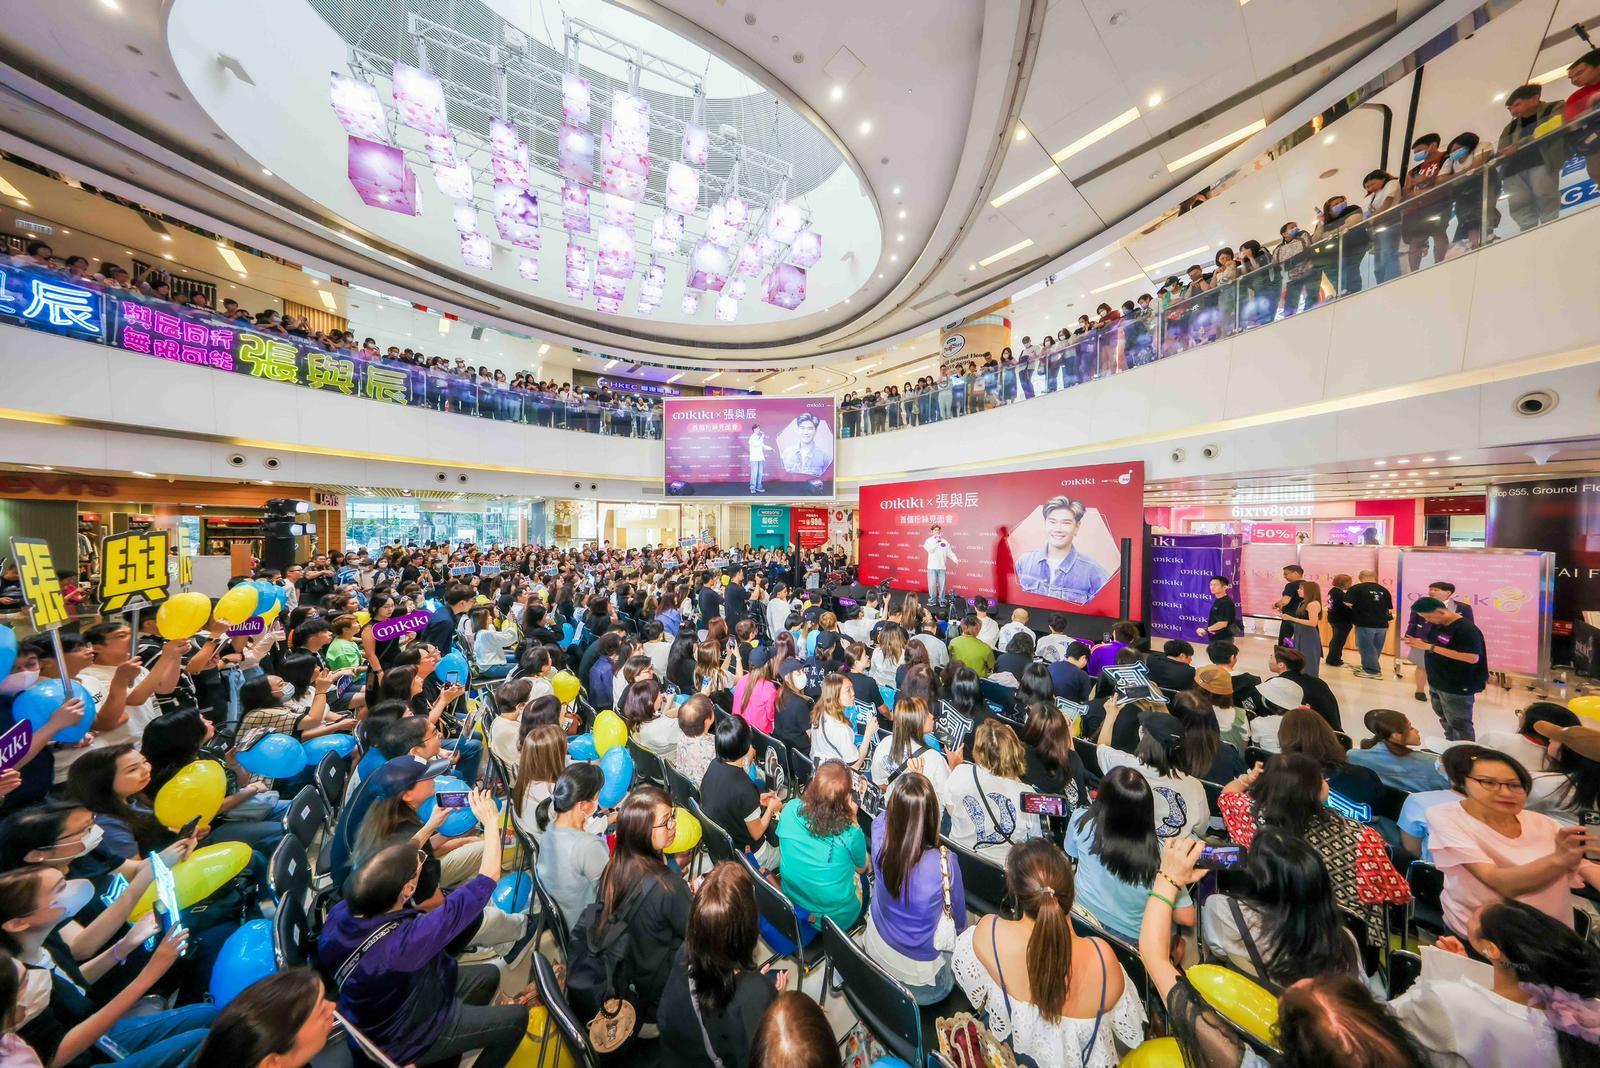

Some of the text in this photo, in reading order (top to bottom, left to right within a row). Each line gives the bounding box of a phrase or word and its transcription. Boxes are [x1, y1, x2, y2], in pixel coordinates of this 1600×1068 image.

[122, 301, 233, 350] 與辰同行
[239, 333, 408, 406] 張與辰
[610, 381, 638, 390] HKEC
[672, 410, 714, 420] mikiki
[724, 408, 757, 420] 張與辰
[1061, 478, 1096, 486] mikiki
[1508, 488, 1529, 497] G55,
[1532, 485, 1578, 495] Ground
[880, 497, 924, 510] mikiki
[936, 492, 979, 508] 張與辰
[900, 514, 953, 524] 首個粉絲見面會
[1256, 528, 1290, 539] 50%
[1152, 578, 1184, 586] mikiki
[1179, 592, 1213, 600] mikiki
[1152, 600, 1183, 609] mikiki
[1178, 614, 1208, 623] mikik
[376, 615, 429, 638] mikiki
[1151, 622, 1182, 632] mikiki
[0, 731, 28, 768] kiki
